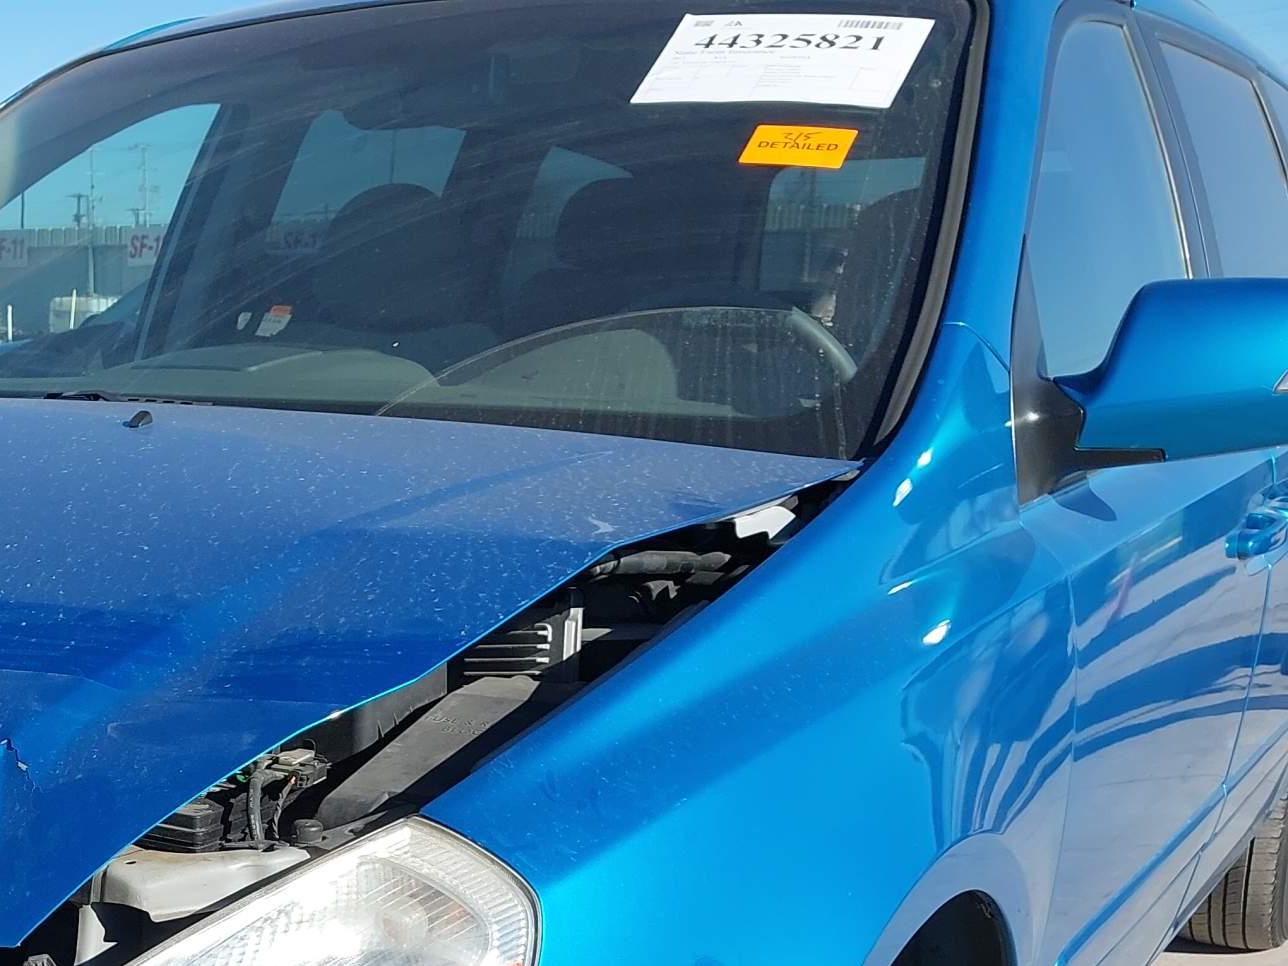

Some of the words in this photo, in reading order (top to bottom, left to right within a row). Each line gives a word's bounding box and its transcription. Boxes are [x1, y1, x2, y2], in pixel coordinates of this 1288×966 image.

[694, 32, 885, 51] 44325821
[757, 140, 839, 151] DETAILED
[129, 234, 162, 259] SF-1
